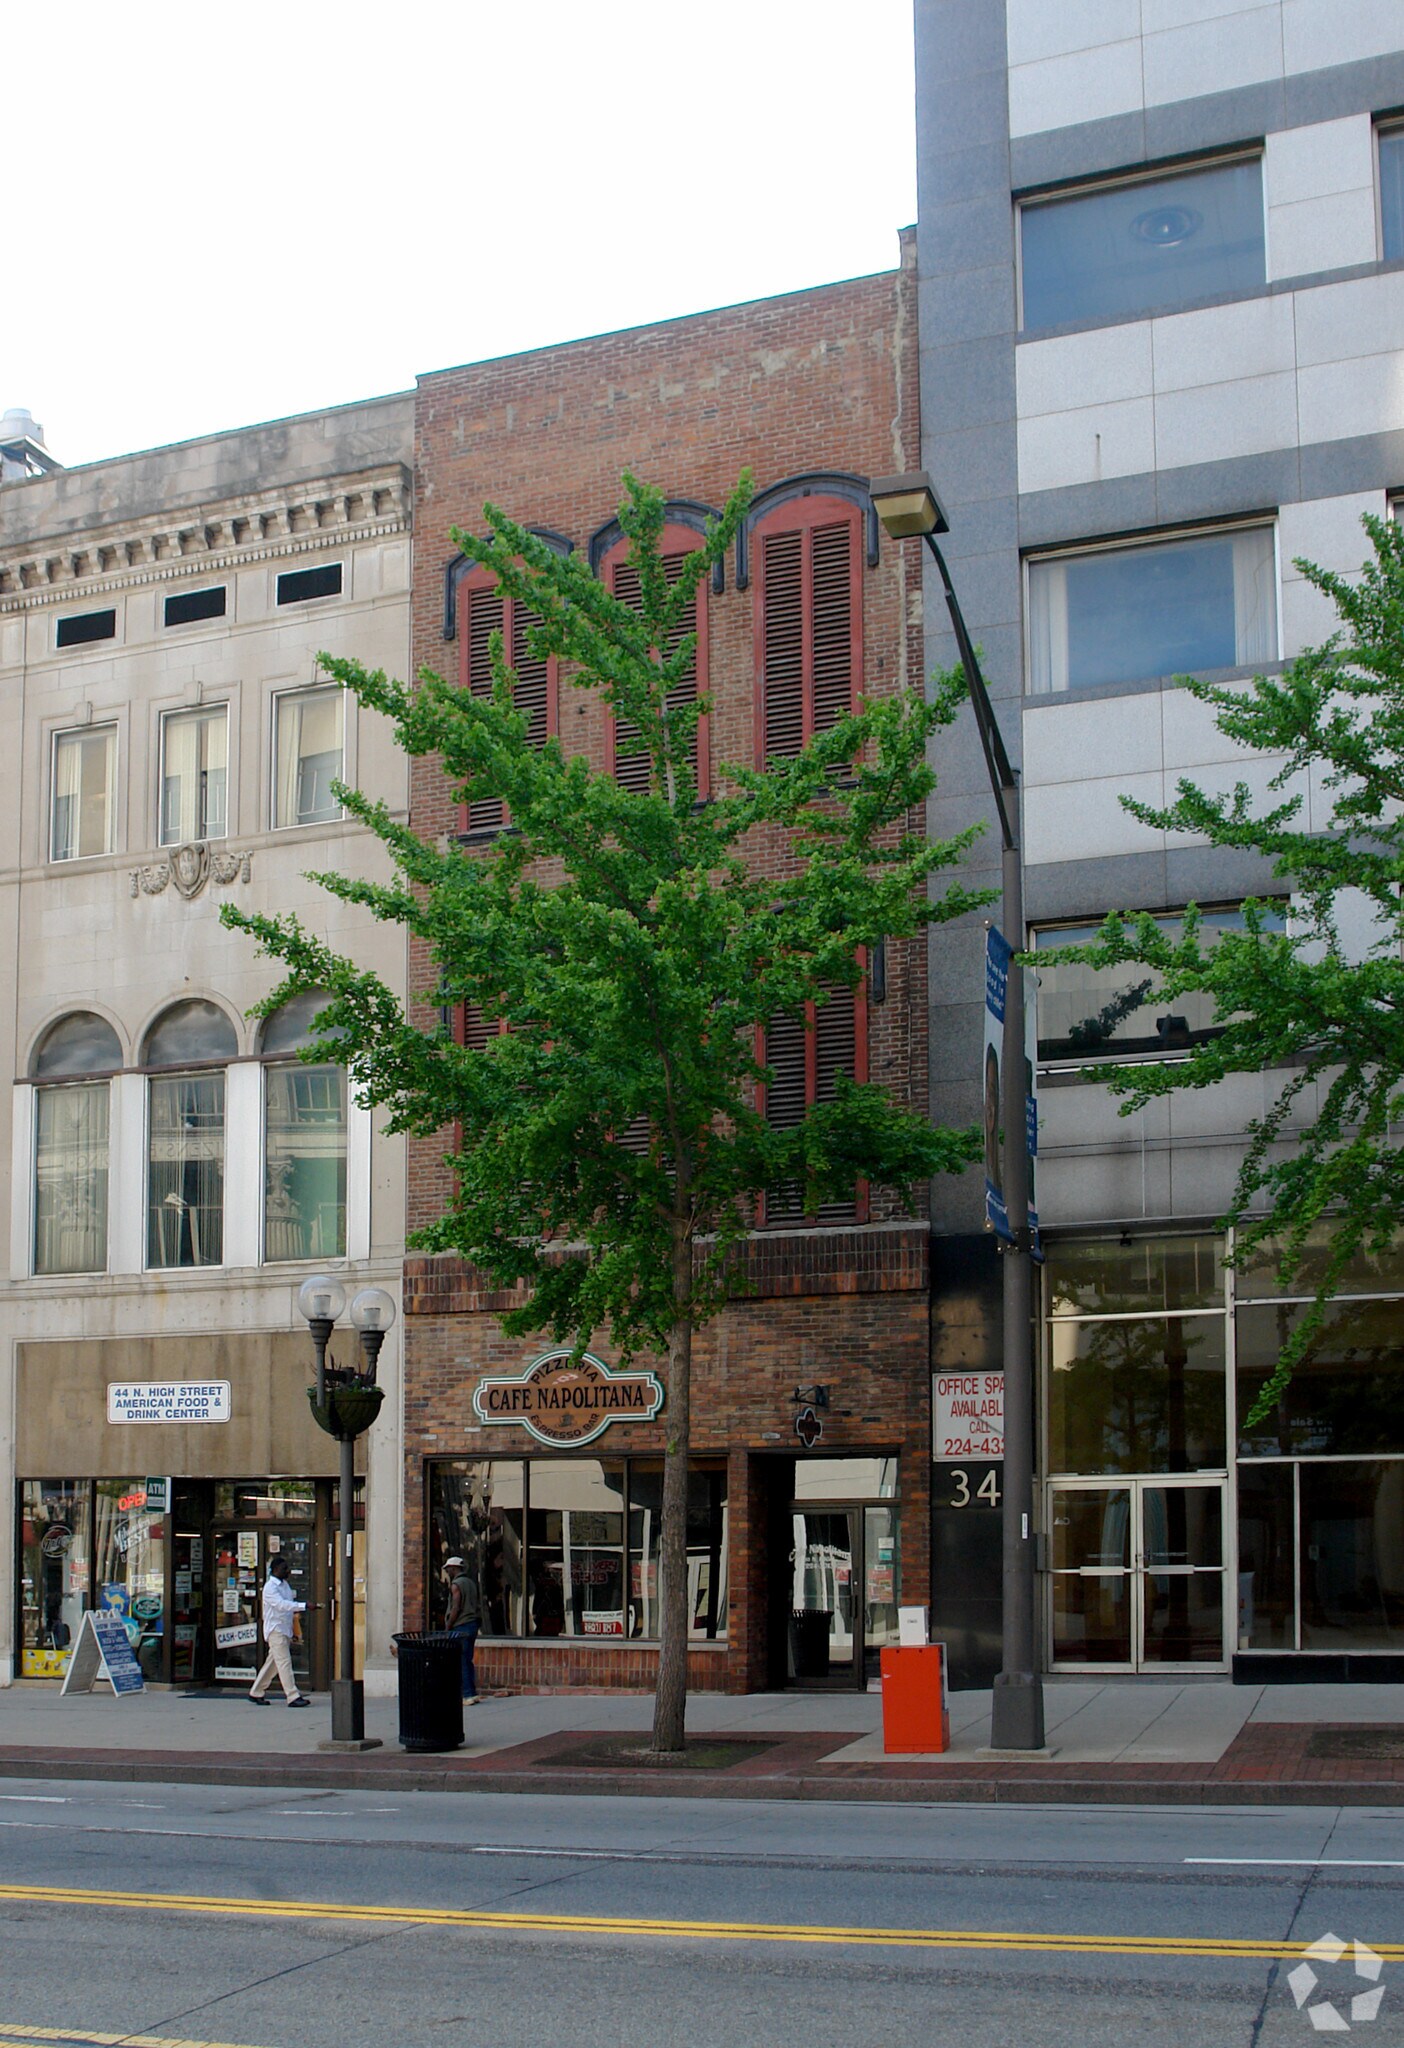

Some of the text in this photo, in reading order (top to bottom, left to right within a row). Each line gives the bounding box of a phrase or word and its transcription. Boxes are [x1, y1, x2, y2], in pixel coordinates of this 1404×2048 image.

[115, 1386, 223, 1397] 44 N. HIGH STREET
[938, 1378, 979, 1396] OFFICE
[115, 1397, 222, 1408] AMERICAN FOOD &
[489, 1385, 645, 1410] CAFE NAPOLITANA
[127, 1409, 209, 1419] DRINK CENTER
[530, 1413, 601, 1439] ESPRESSO BAR
[969, 1421, 991, 1434] CALL
[148, 1482, 165, 1495] ATM
[950, 1469, 1002, 1508] 34
